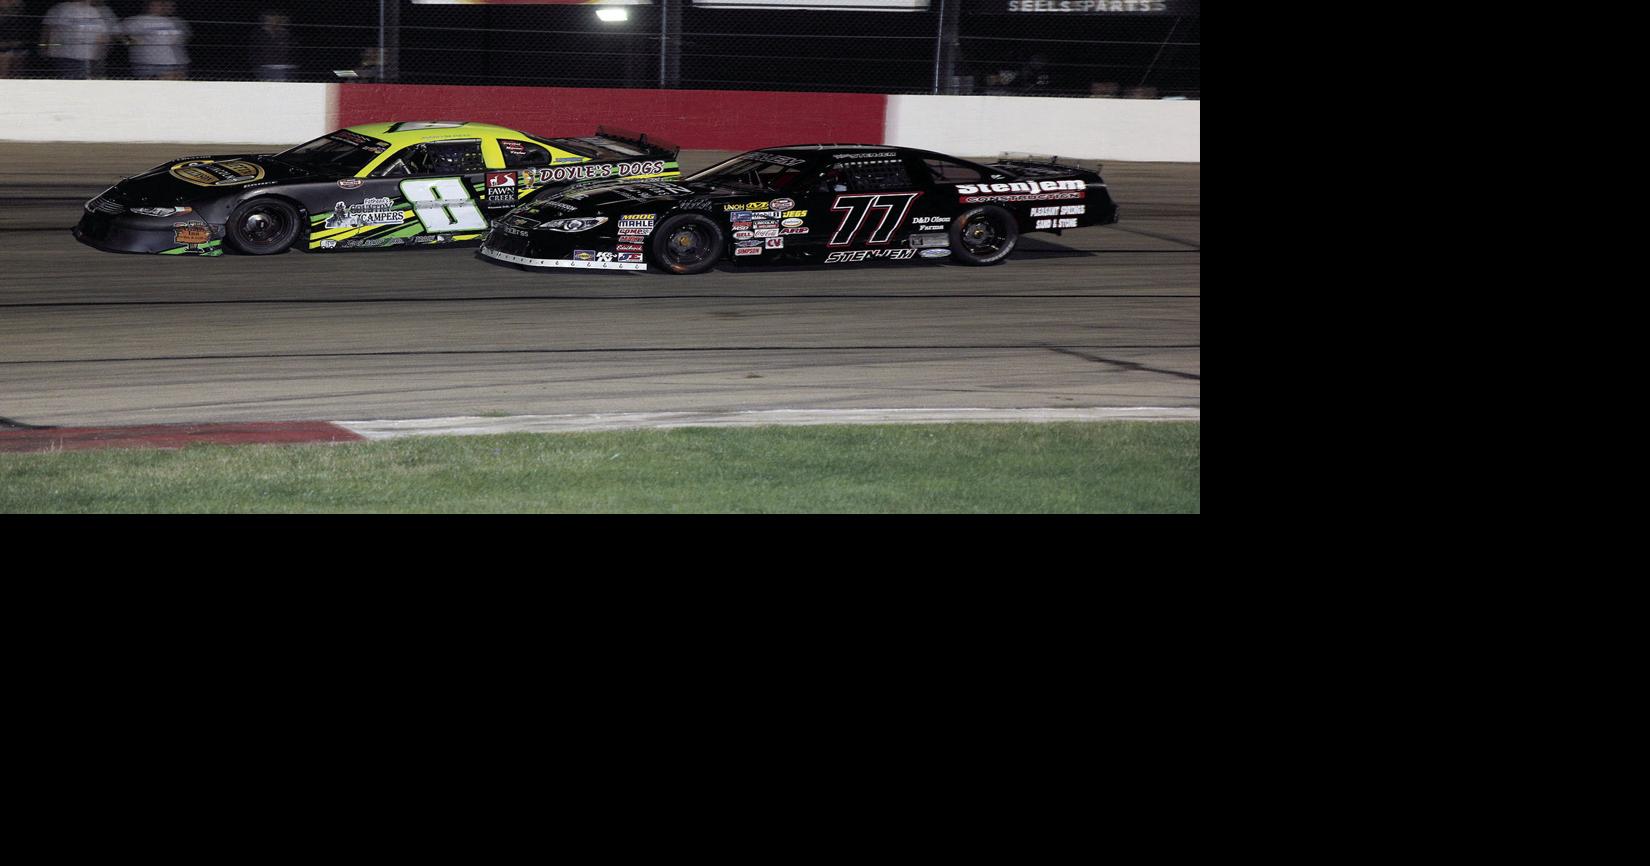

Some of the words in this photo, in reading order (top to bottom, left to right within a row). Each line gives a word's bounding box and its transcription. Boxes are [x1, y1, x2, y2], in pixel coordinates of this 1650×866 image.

[540, 165, 612, 182] DOYLE'S
[618, 161, 665, 176] DOGS
[488, 187, 515, 195] FAWN
[955, 180, 1086, 194] Stenjem
[966, 192, 1081, 203] CONSTRUCTION
[361, 211, 404, 221] CAMPERS
[782, 210, 808, 218] JEGS
[1030, 206, 1060, 217] PLEASANT
[826, 192, 924, 249] 77
[767, 239, 781, 247] CV
[824, 248, 918, 264] STENJEM
